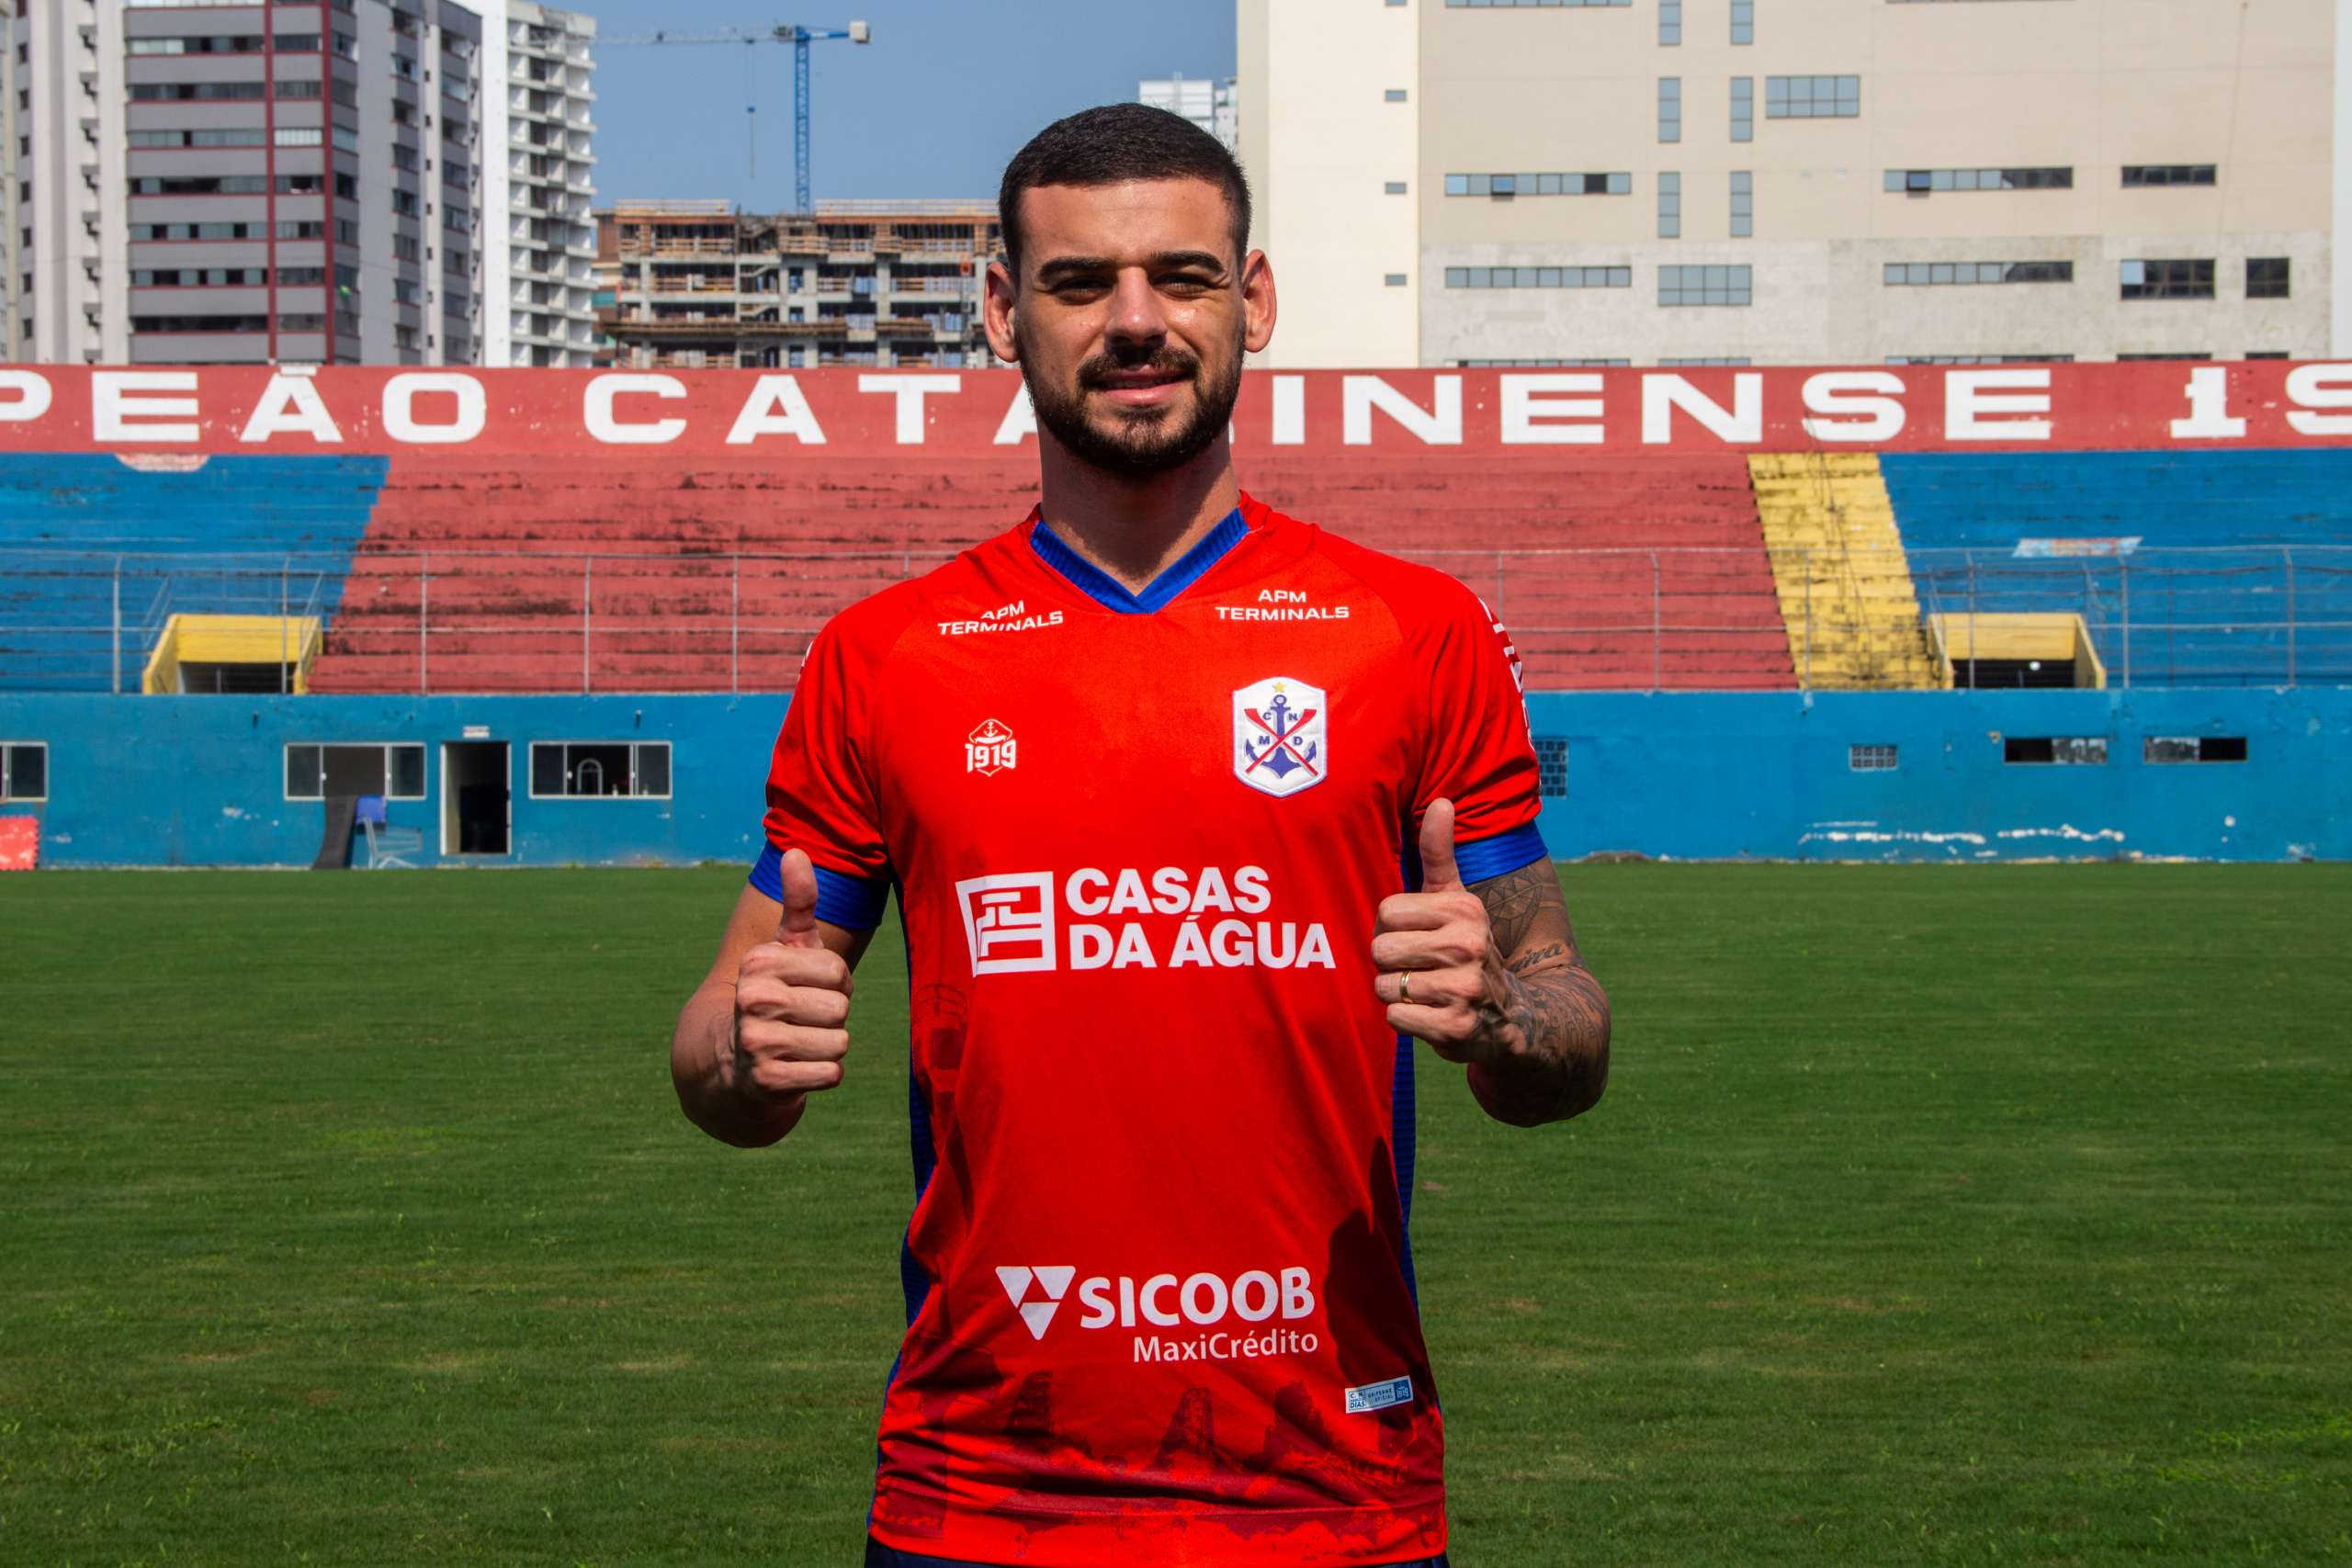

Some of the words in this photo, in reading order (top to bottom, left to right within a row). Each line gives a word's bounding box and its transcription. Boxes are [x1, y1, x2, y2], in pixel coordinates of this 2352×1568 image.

[980, 600, 1025, 620] APM
[1215, 605, 1350, 621] TERMINALS
[1257, 589, 1306, 604] APM
[937, 610, 1064, 636] TERMINALS
[964, 739, 1017, 773] 1919
[1065, 865, 1272, 917] CASAS
[1069, 923, 1158, 970] DA
[1168, 915, 1337, 970] ÁGUA
[1079, 1267, 1316, 1329] SICOOB
[1133, 1328, 1318, 1362] MaxiCrédito
